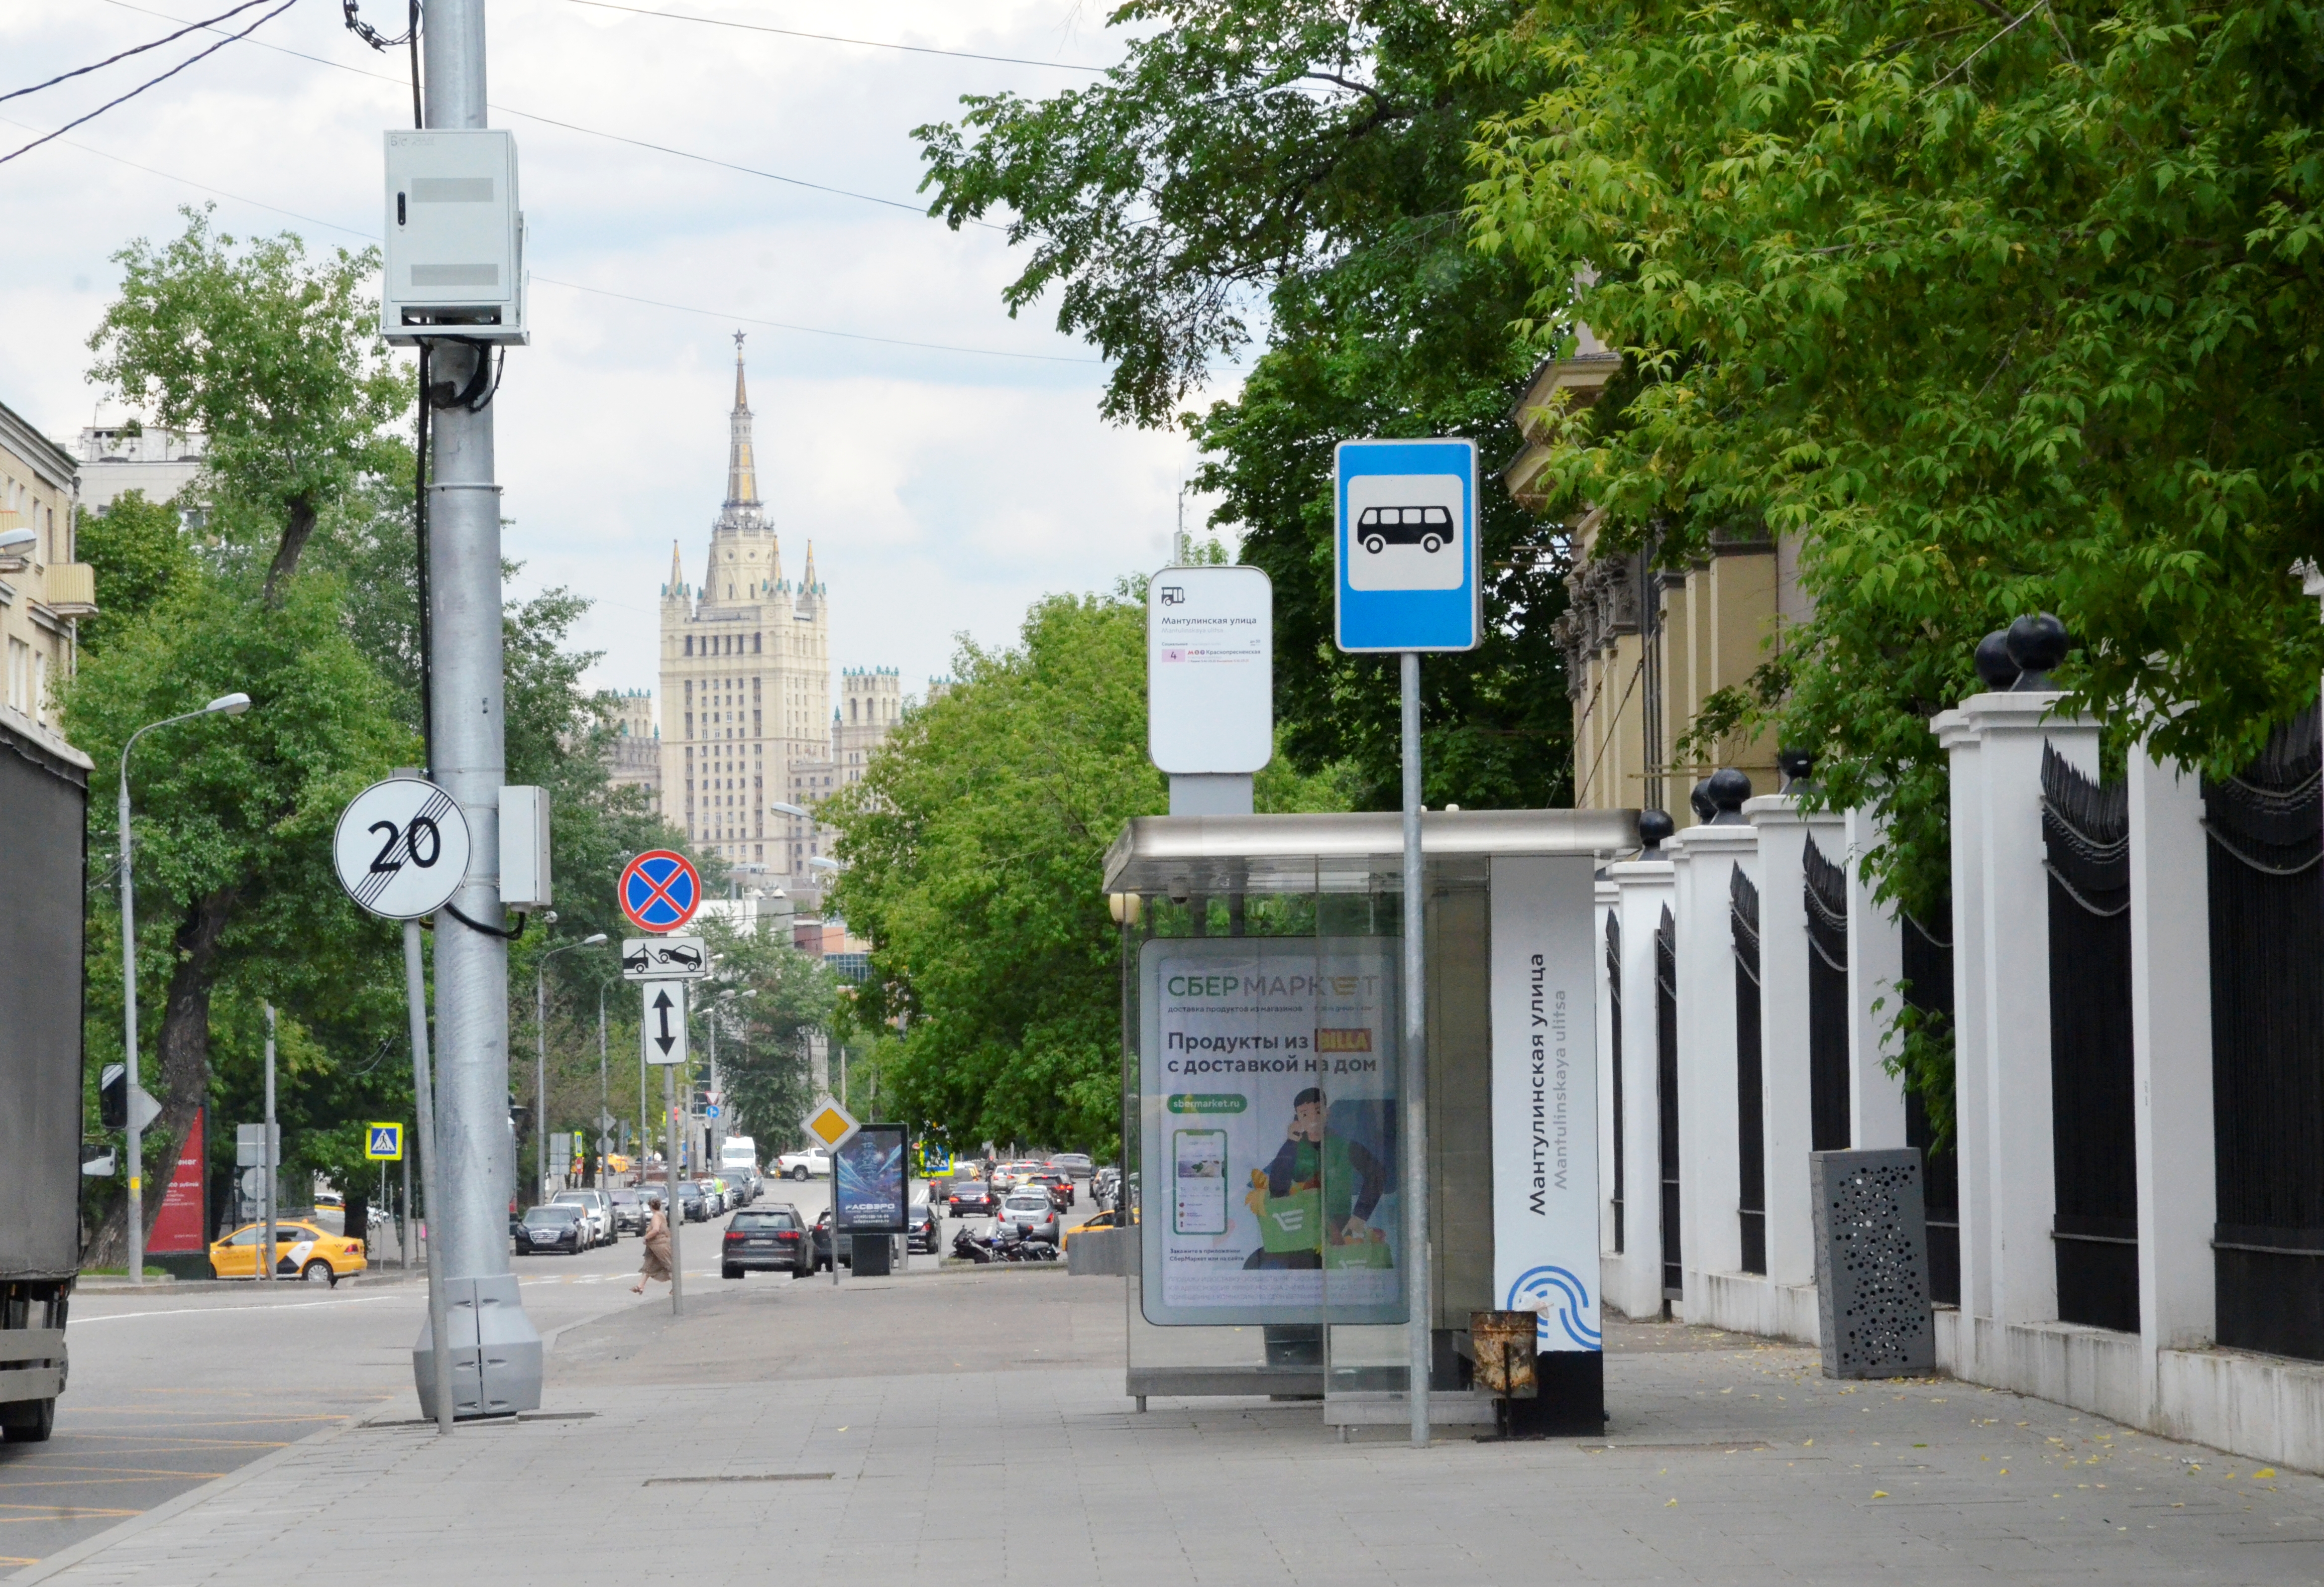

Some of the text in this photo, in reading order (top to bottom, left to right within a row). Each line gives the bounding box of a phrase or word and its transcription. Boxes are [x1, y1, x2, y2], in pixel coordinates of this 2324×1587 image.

[1161, 617, 1257, 626] Мантулинская улица
[1170, 651, 1177, 659] 4
[368, 816, 440, 873] 20
[1168, 1031, 1368, 1054] Продукты из BILLA
[1167, 1055, 1377, 1075] с доставкой на дом
[1529, 954, 1548, 1216] Мантулинская улица
[1552, 990, 1569, 1190] Mantulinskaya ulitsa
[1173, 1099, 1240, 1108] sbermarket.ru
